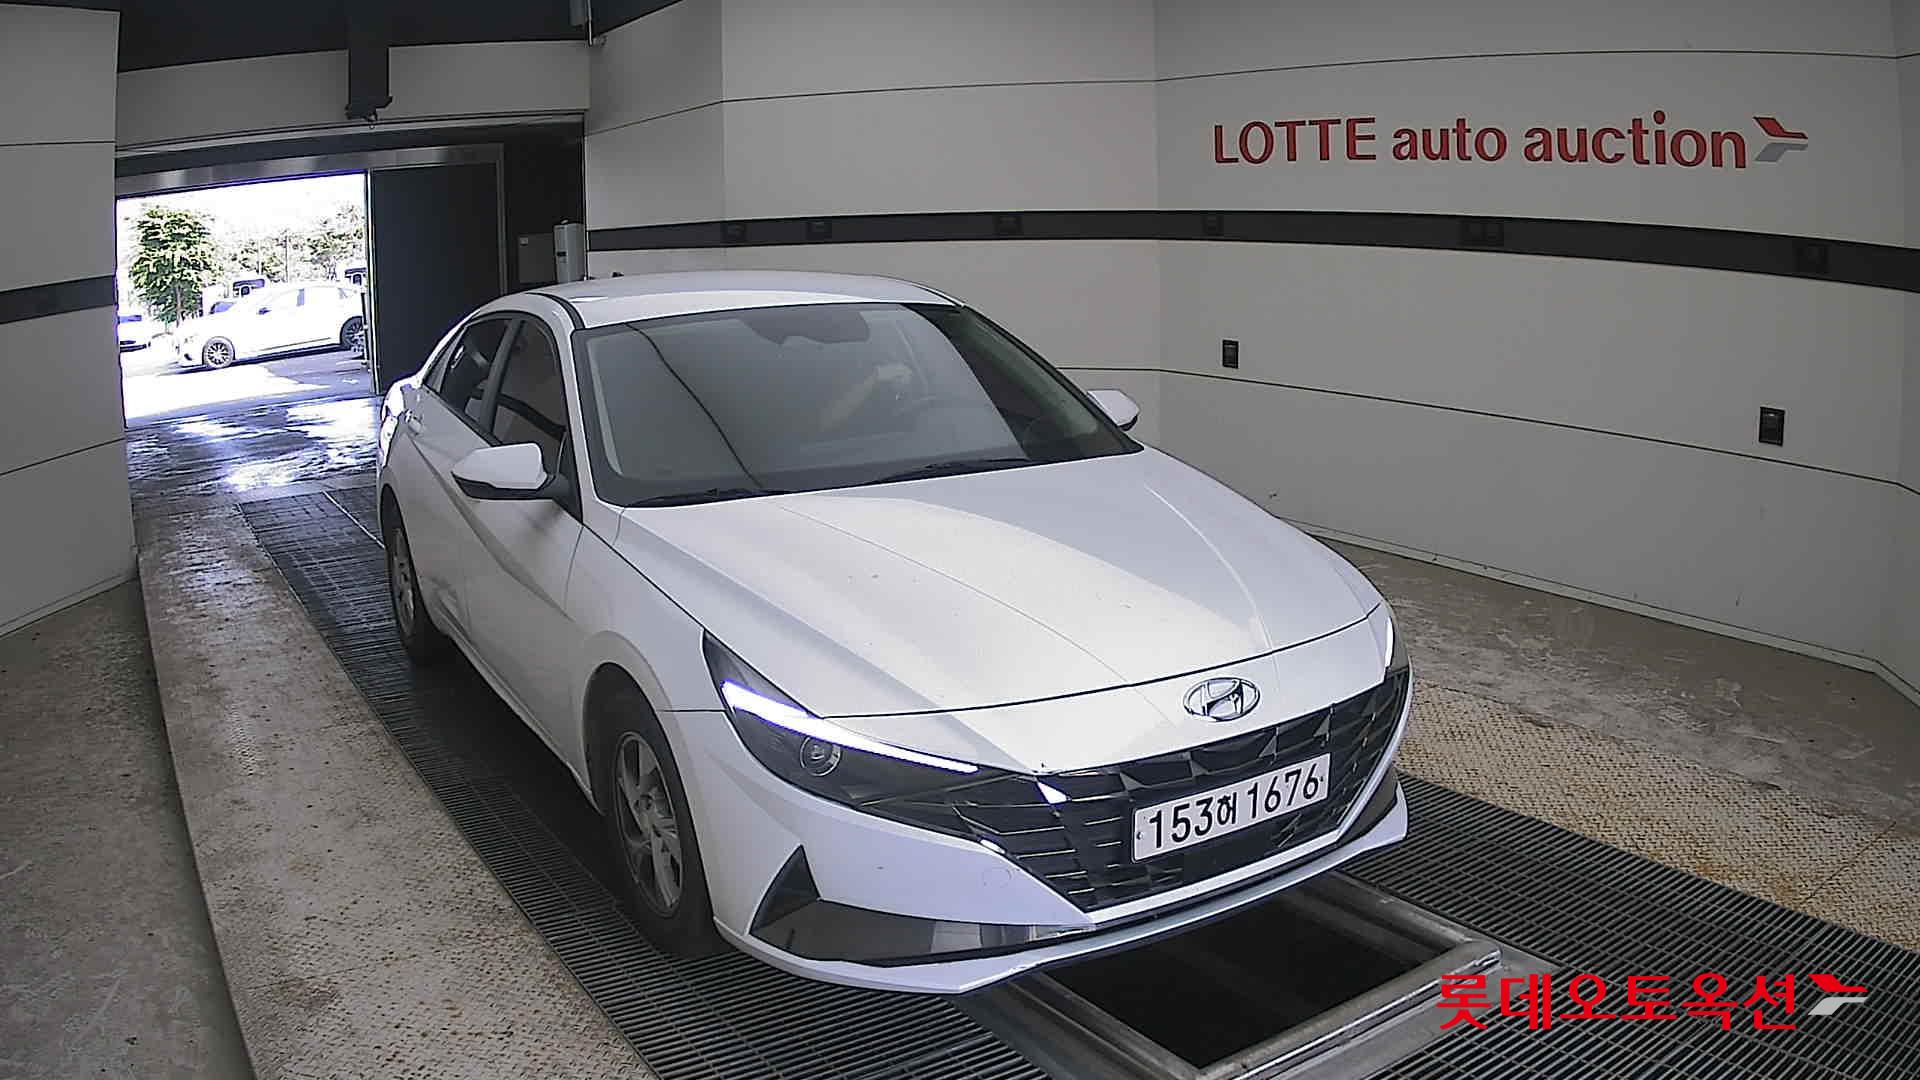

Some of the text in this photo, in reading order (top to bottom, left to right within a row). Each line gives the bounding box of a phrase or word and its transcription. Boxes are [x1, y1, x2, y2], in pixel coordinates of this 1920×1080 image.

[1213, 110, 1747, 169] LOTTE auto auction
[1149, 762, 1319, 849] 153허 1676
